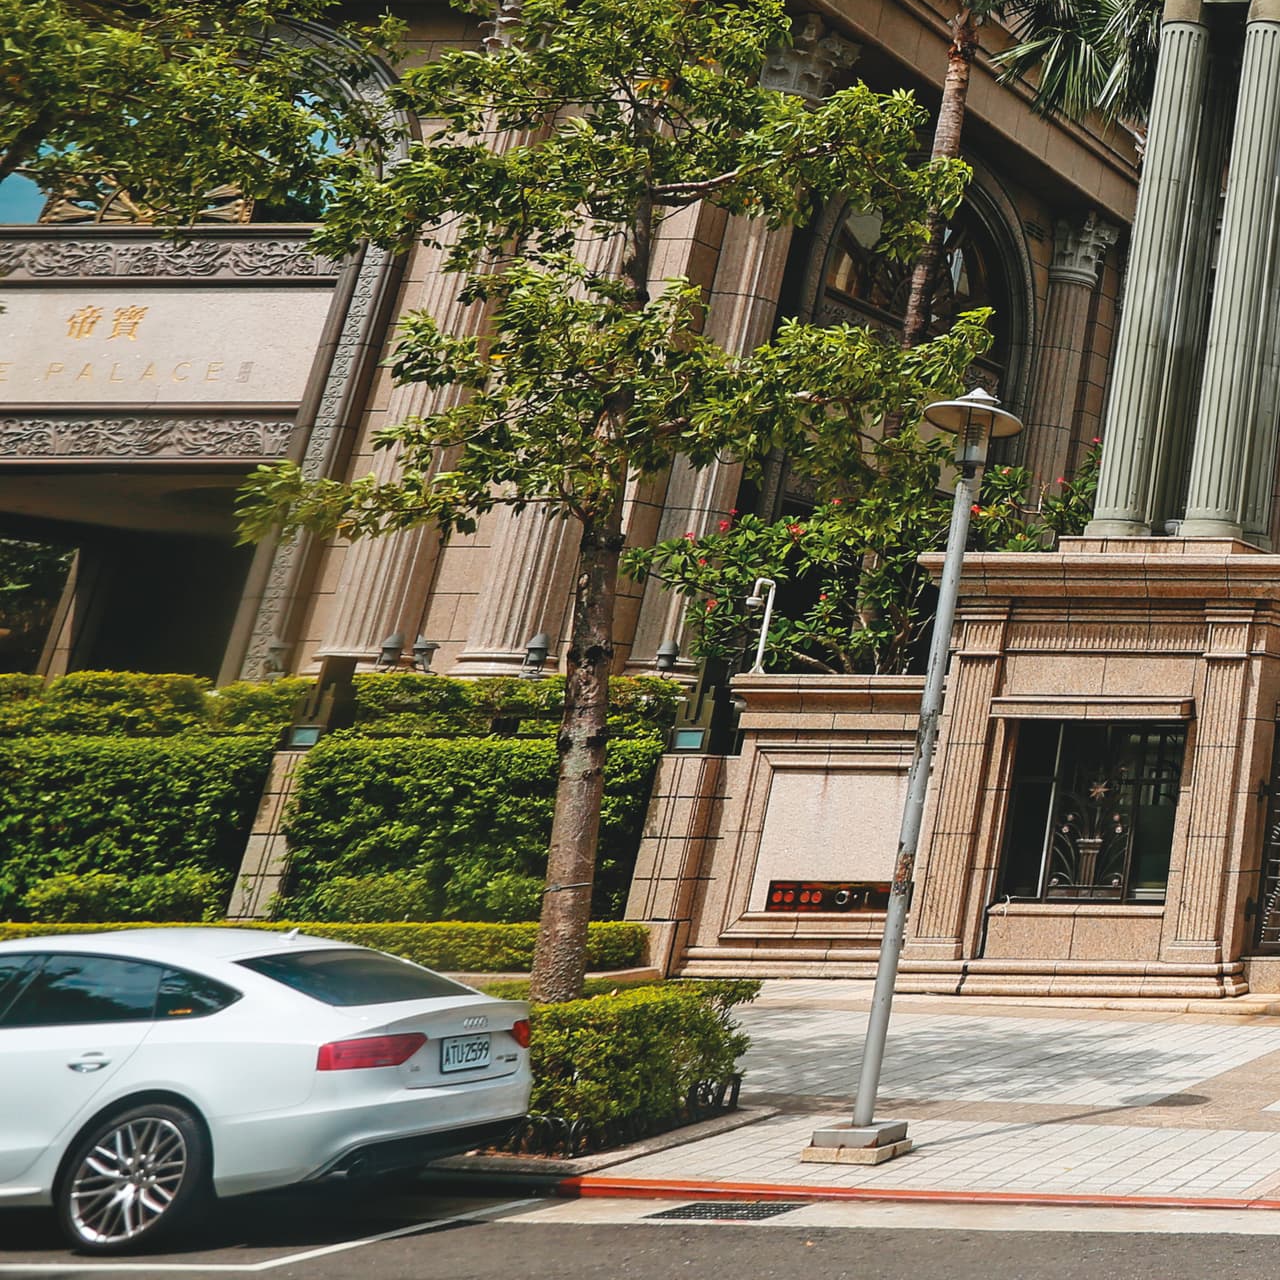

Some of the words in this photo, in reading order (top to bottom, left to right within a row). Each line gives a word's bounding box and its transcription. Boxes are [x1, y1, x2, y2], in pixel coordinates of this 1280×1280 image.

[66, 304, 149, 341] 帝寶
[44, 361, 224, 383] PALACE
[444, 1040, 489, 1065] ATU-2599
